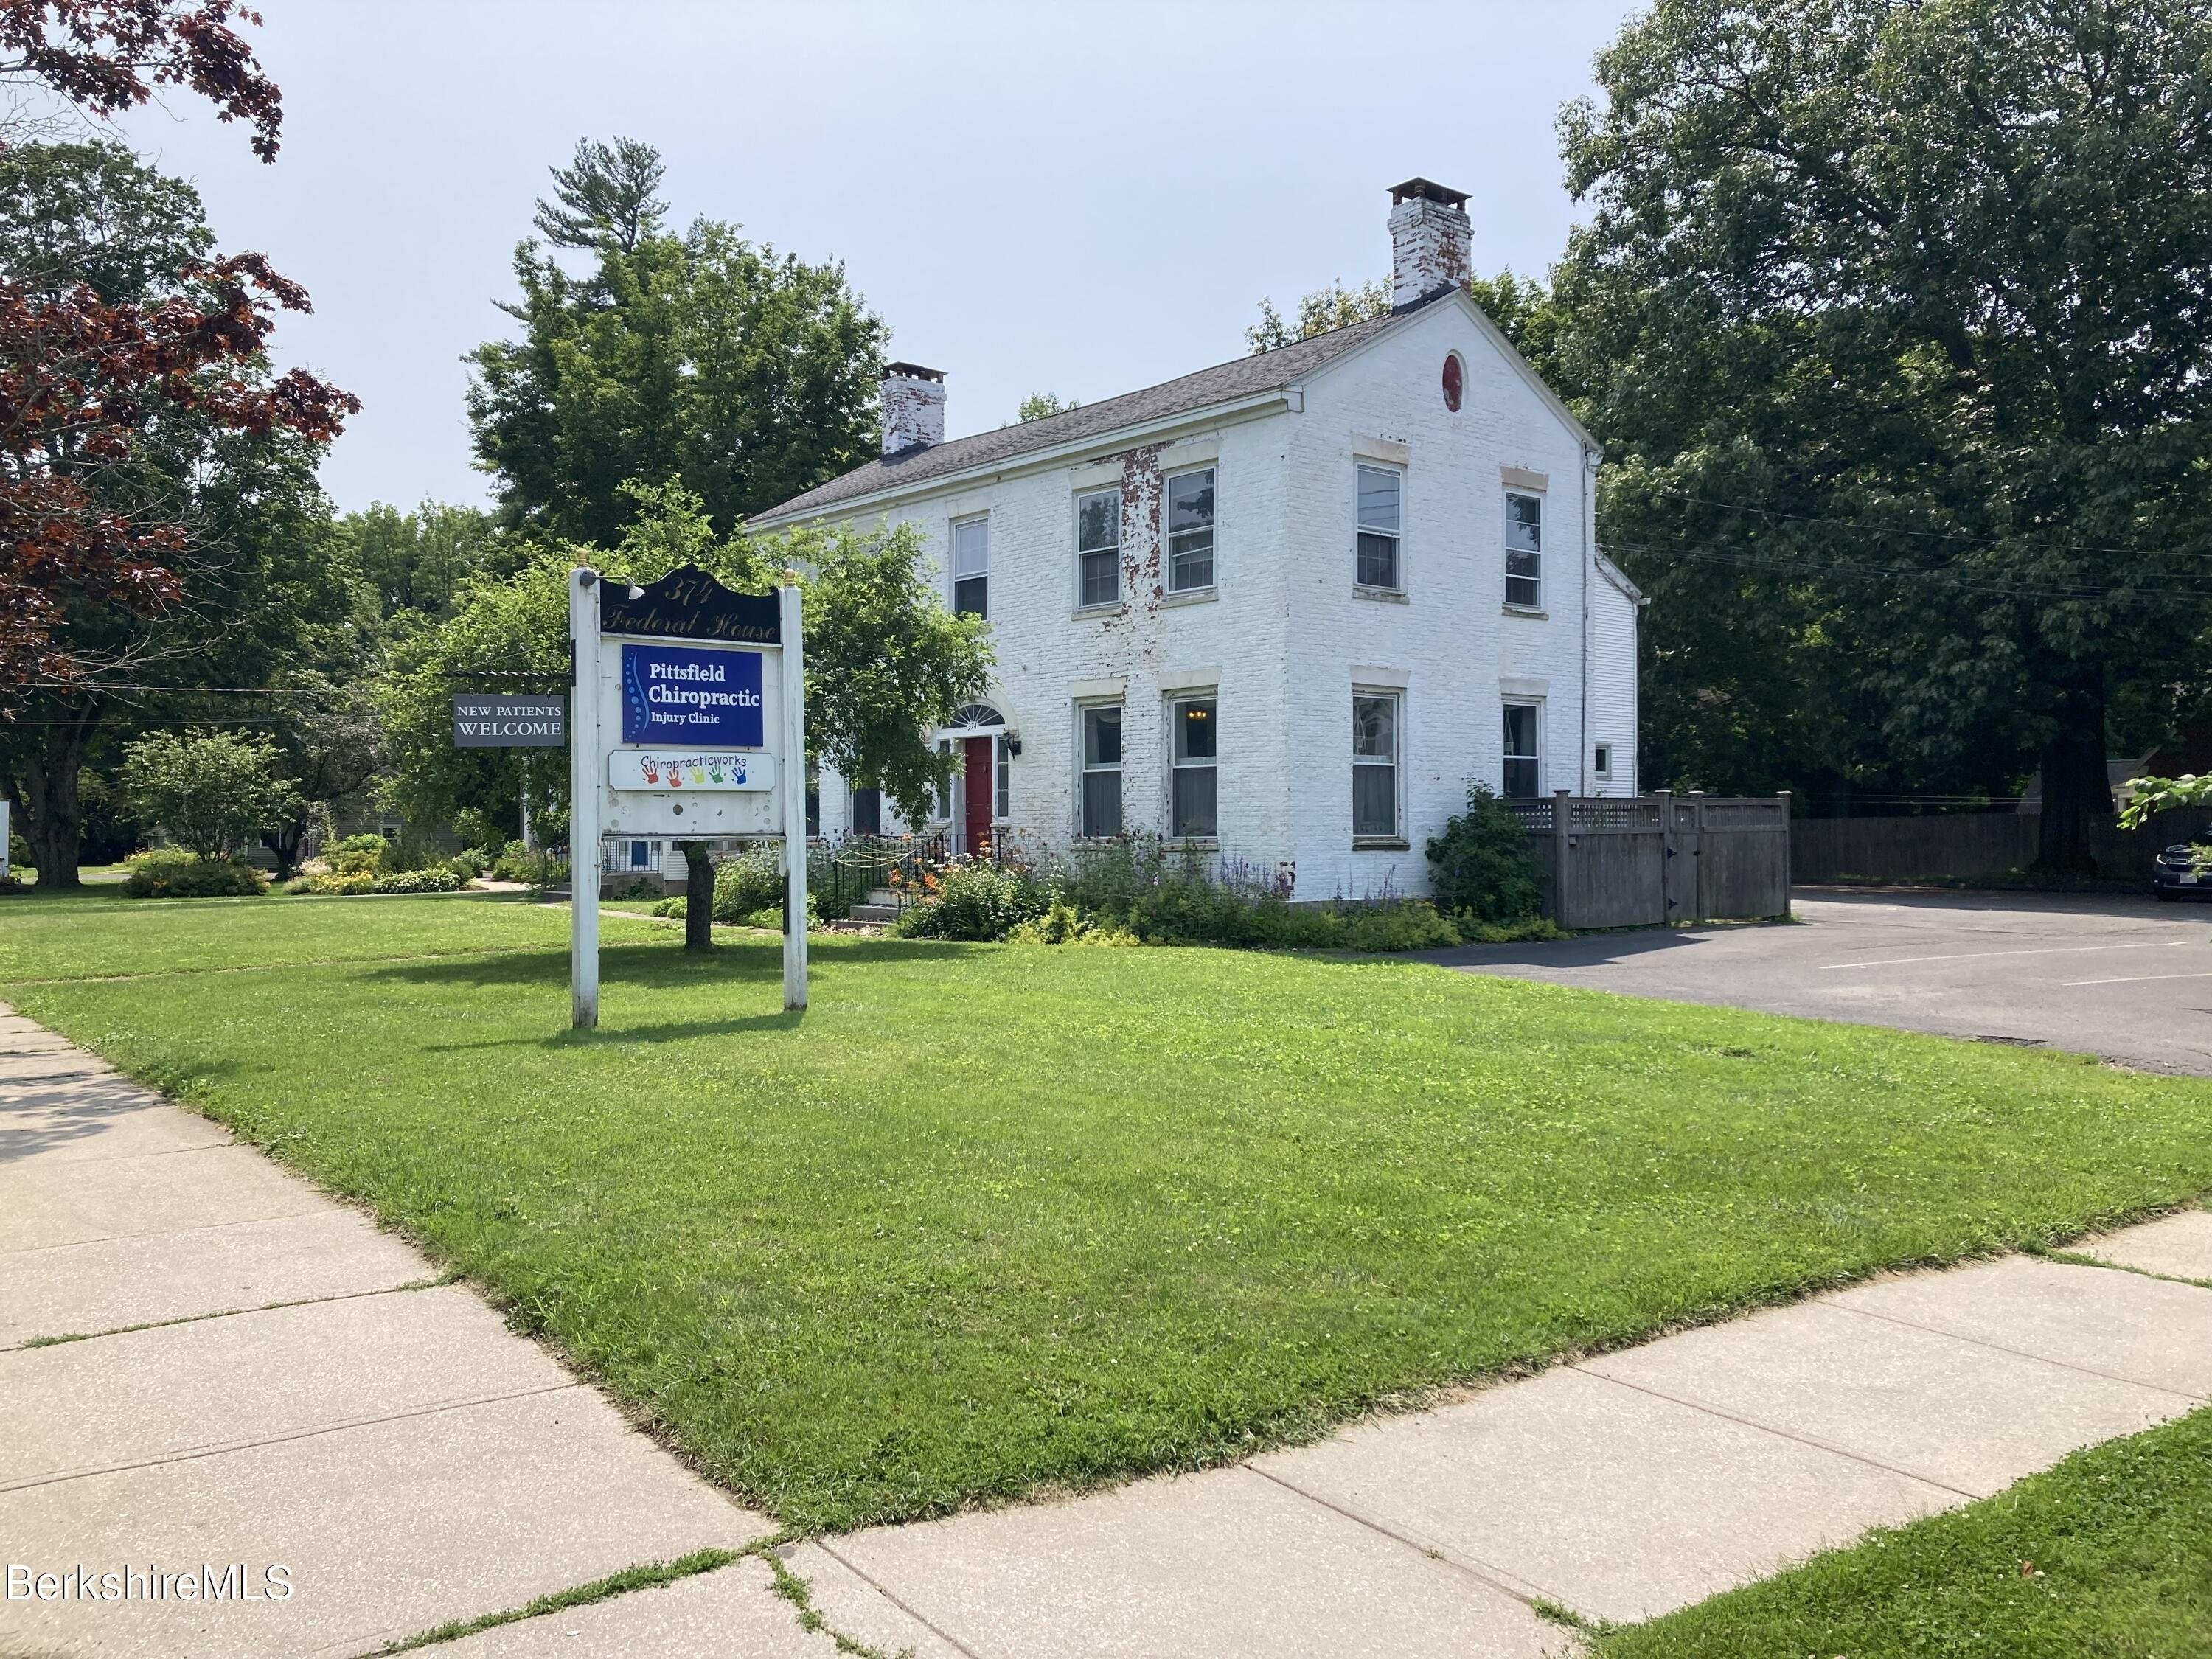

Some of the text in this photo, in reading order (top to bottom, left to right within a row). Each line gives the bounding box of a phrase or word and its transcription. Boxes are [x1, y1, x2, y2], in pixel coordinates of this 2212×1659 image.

[665, 577, 713, 606] 374
[602, 604, 776, 640] Federal House
[650, 663, 726, 682] Pittsfield
[648, 684, 760, 709] Chiropractic
[457, 706, 561, 717] NEW PATIENTS
[650, 712, 720, 725] Injury Clinic
[458, 722, 561, 736] WELCOME
[641, 755, 747, 769] Chiropracticworks
